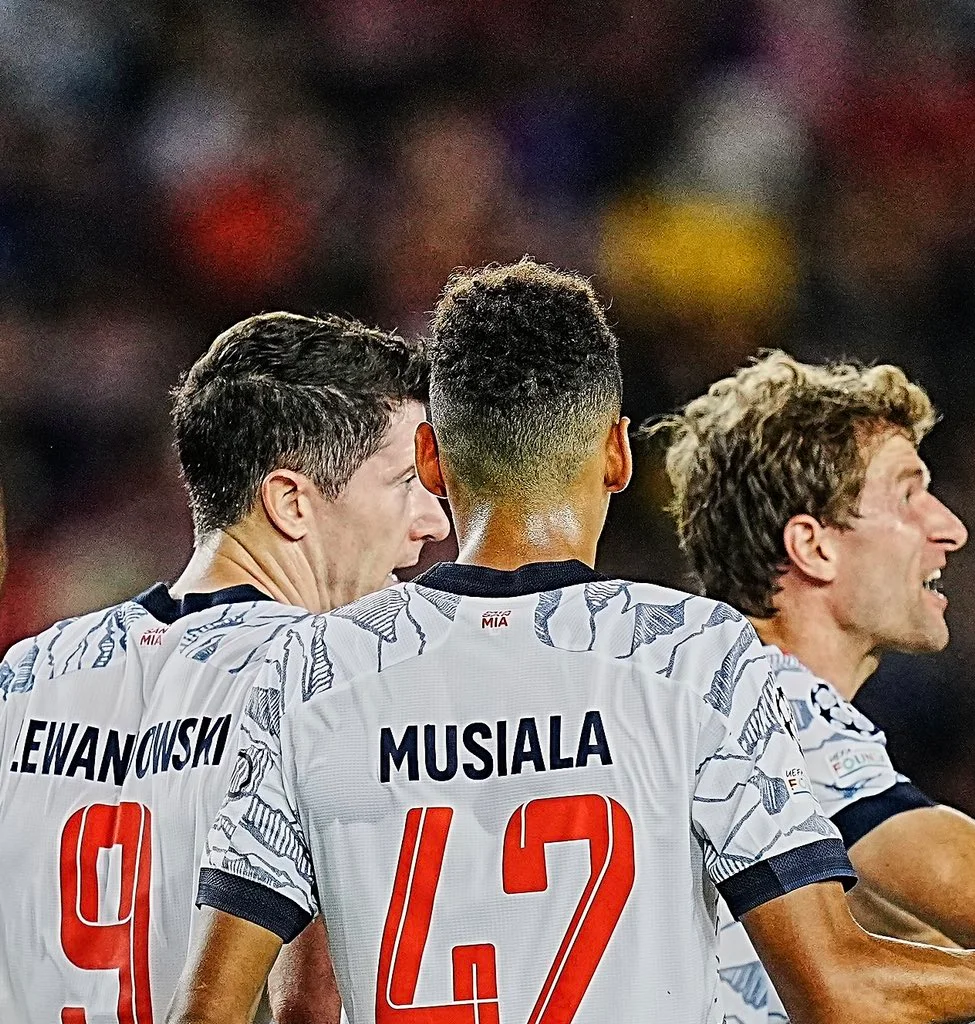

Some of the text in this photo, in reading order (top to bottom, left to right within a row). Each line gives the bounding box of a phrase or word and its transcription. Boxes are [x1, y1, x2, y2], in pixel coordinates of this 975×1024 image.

[140, 634, 162, 646] MIA
[481, 616, 509, 629] MIA
[9, 713, 232, 787] EWANOWSKI
[380, 710, 613, 783] MUSIALA
